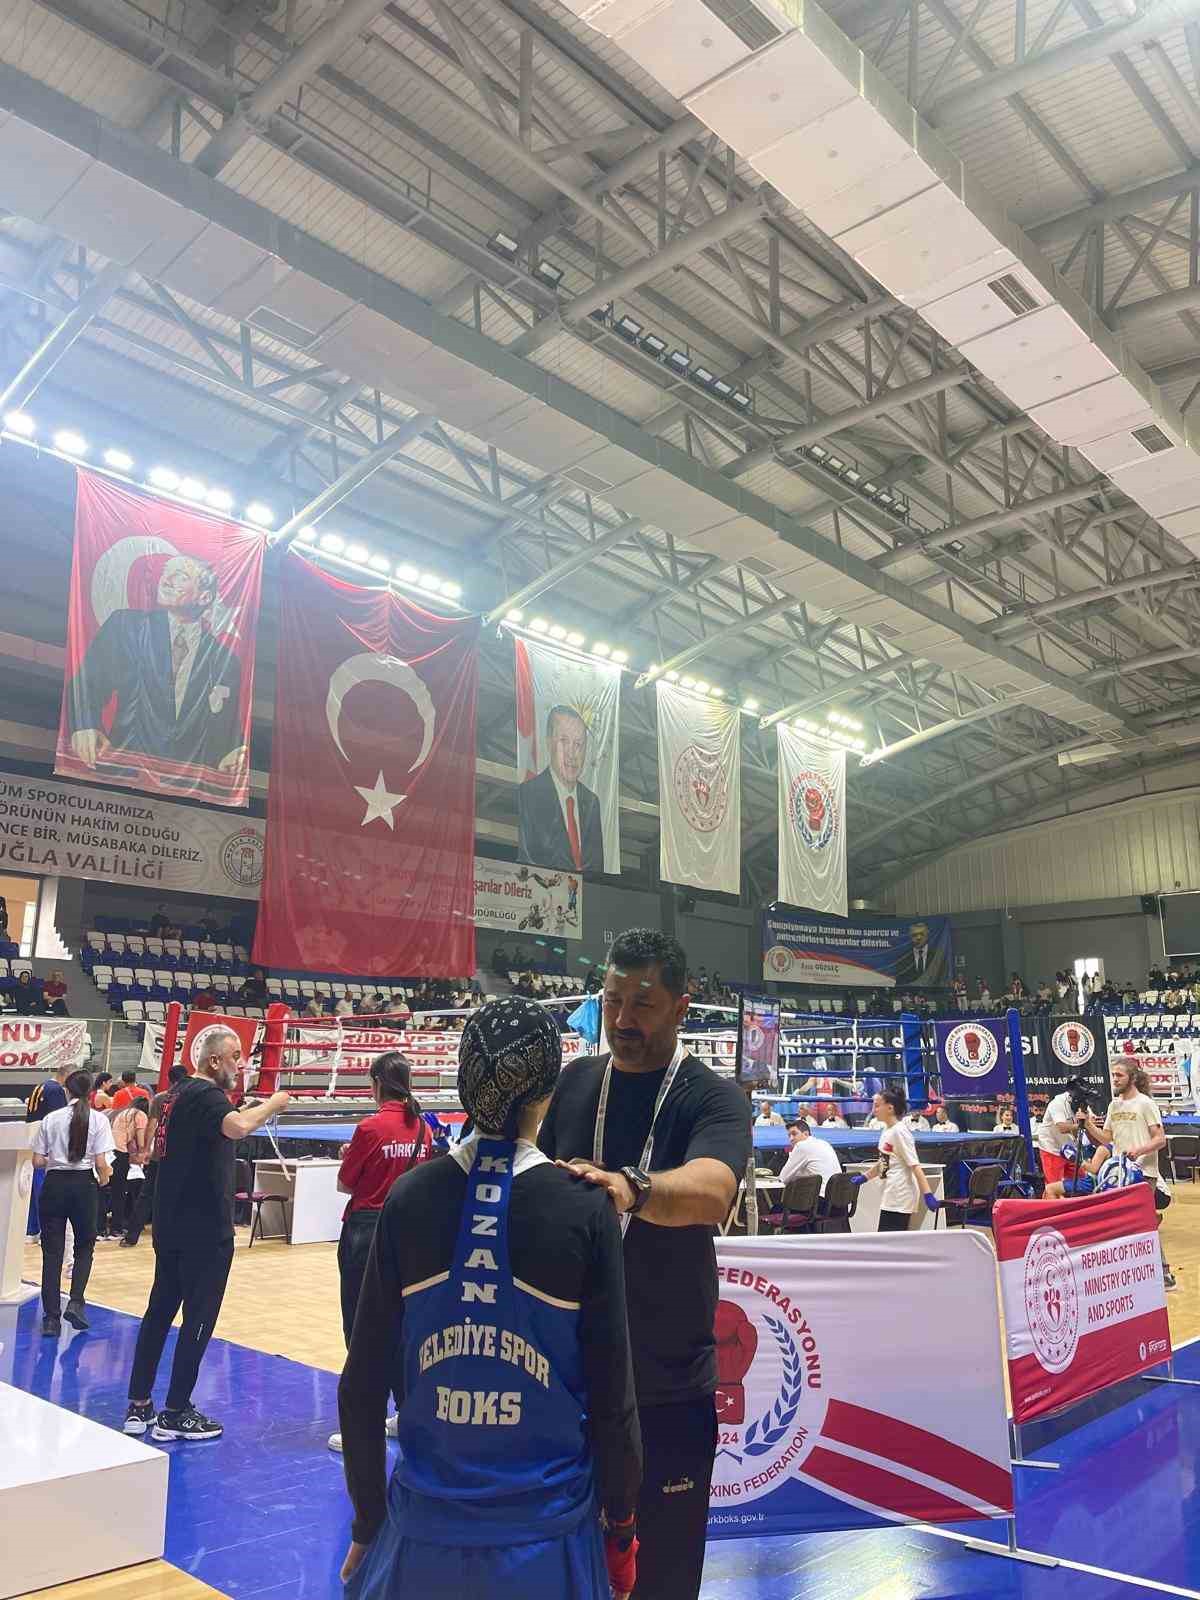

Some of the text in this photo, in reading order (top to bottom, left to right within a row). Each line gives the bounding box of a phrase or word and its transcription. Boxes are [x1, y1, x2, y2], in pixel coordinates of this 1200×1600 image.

[27, 788, 154, 820] SPORCULARIMIZA
[67, 831, 146, 854] MÜSABAKA
[71, 814, 119, 833] HAKİM
[124, 823, 180, 842] OLDUĞU
[66, 852, 163, 880] VALİLİĞİ
[504, 881, 533, 899] Dileriz
[461, 1155, 508, 1304] KOZAN
[1081, 1239, 1154, 1270] REPUBLIC OF TURKEY
[1084, 1263, 1156, 1297] MINISTRY OF YOUTH
[1088, 1294, 1134, 1324] AND SPORTS
[716, 1266, 822, 1389] FEDERASYONU
[500, 1329, 550, 1389] SPOR
[436, 1386, 522, 1425] BOKS
[709, 1426, 809, 1497] XING FEDERATION
